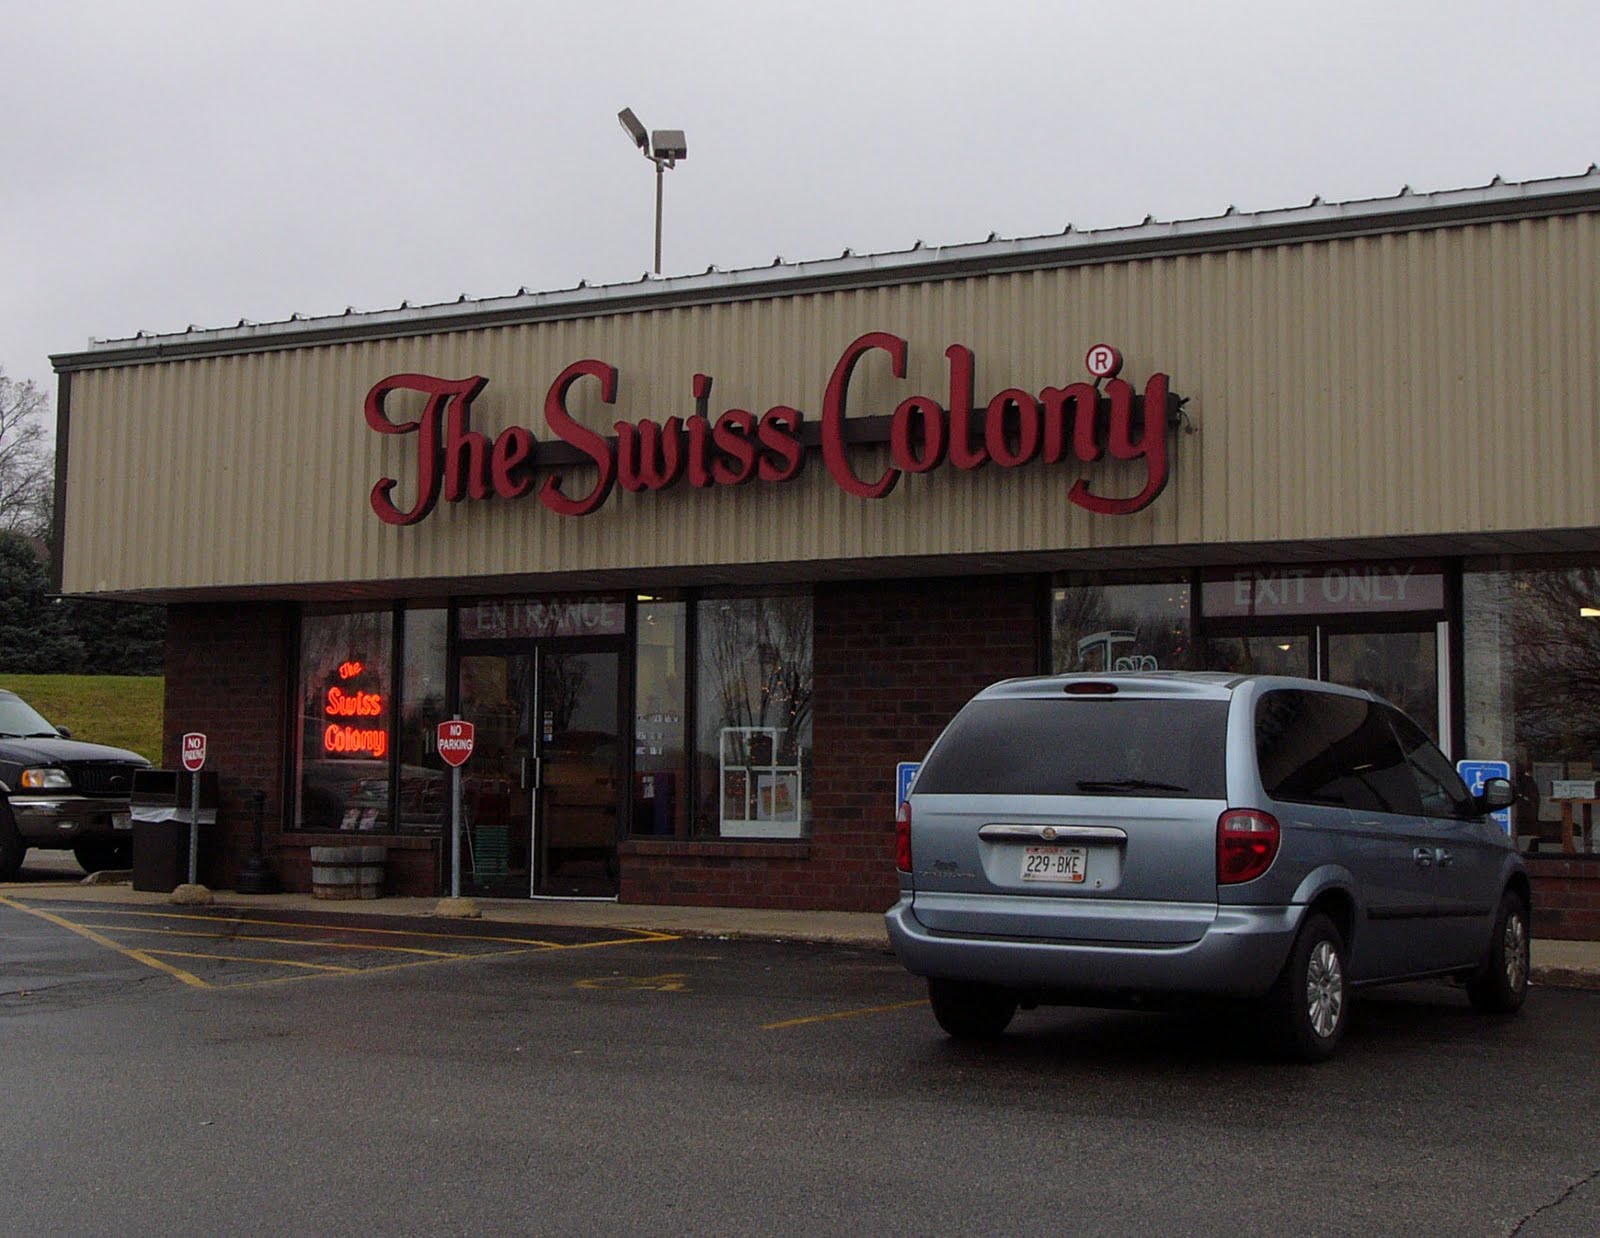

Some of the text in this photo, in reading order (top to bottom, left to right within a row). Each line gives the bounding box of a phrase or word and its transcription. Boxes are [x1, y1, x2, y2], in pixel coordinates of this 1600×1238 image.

[364, 331, 1170, 526] The Swiss Colony
[1233, 565, 1415, 606] EXIT ONLY
[477, 596, 616, 630] ENTRANCE
[339, 661, 362, 679] The
[326, 686, 382, 716] Swiss
[324, 723, 387, 757] Colony
[449, 724, 462, 736] NO
[188, 738, 201, 749] NO
[439, 738, 473, 750] PARKING
[1026, 855, 1080, 874] 229-BKE
